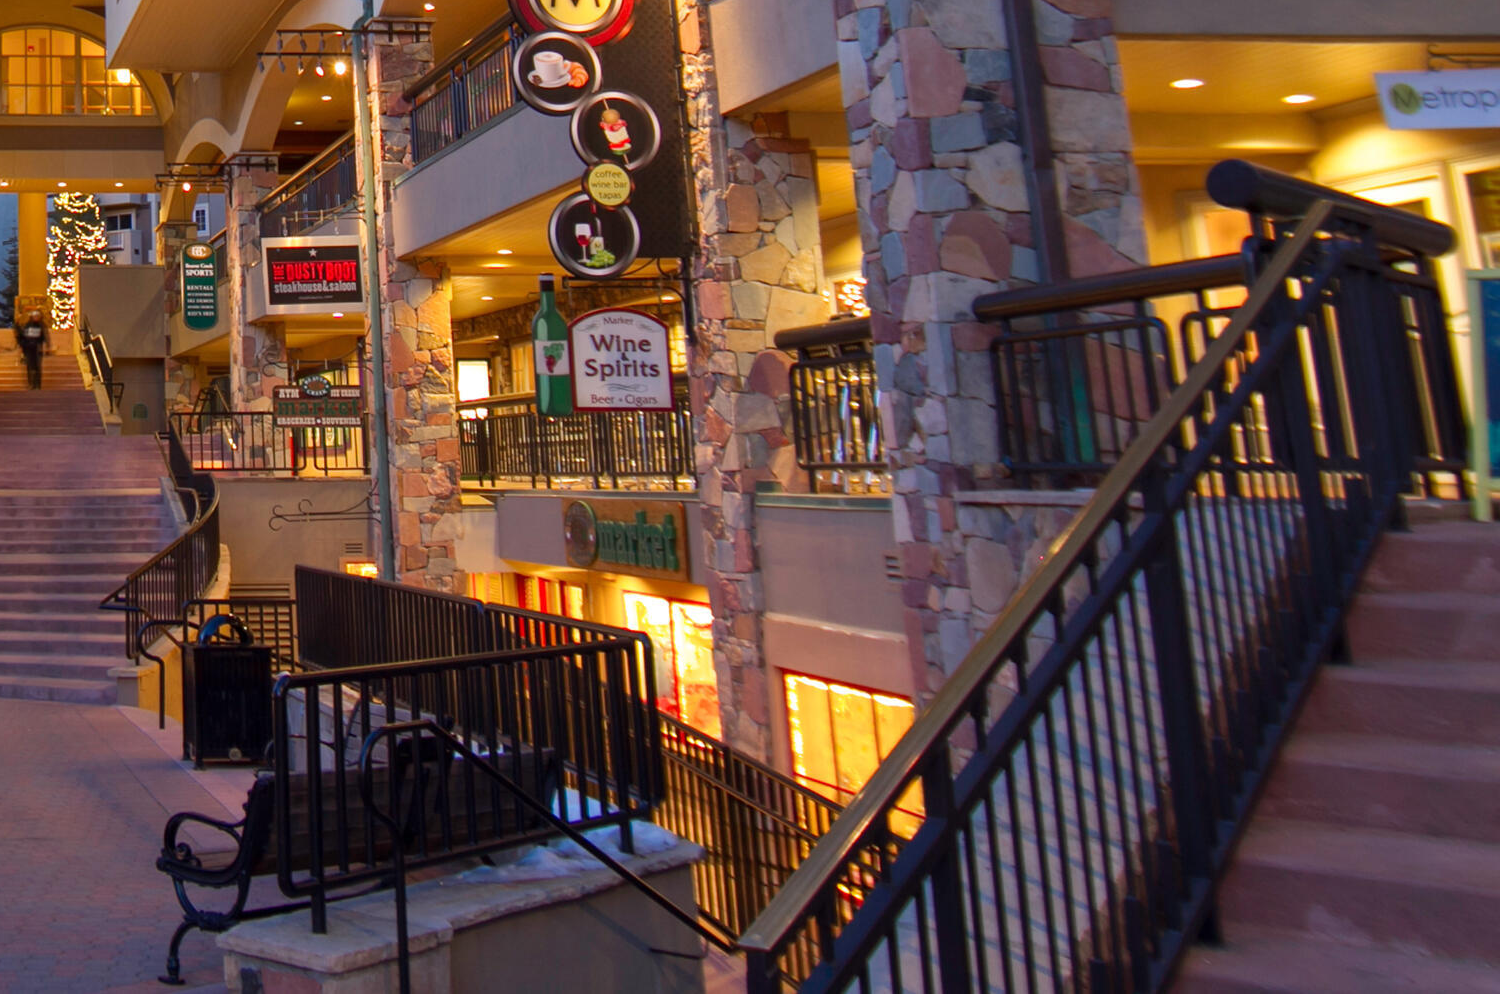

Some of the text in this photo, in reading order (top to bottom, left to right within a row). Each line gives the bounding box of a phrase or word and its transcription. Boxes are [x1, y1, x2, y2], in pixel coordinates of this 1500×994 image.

[595, 170, 622, 179] coffee
[591, 179, 628, 189] wine bar
[598, 191, 622, 200] tapas
[185, 269, 214, 277] SPORTS
[286, 262, 324, 282] DUSTY
[325, 261, 357, 282] BOOT
[603, 317, 634, 325] Market
[590, 334, 652, 353] Wine
[584, 358, 660, 381] Spirits
[279, 388, 300, 399] ATM
[591, 394, 658, 406] Beer Cigars
[277, 397, 359, 416] market
[597, 510, 680, 571] market
